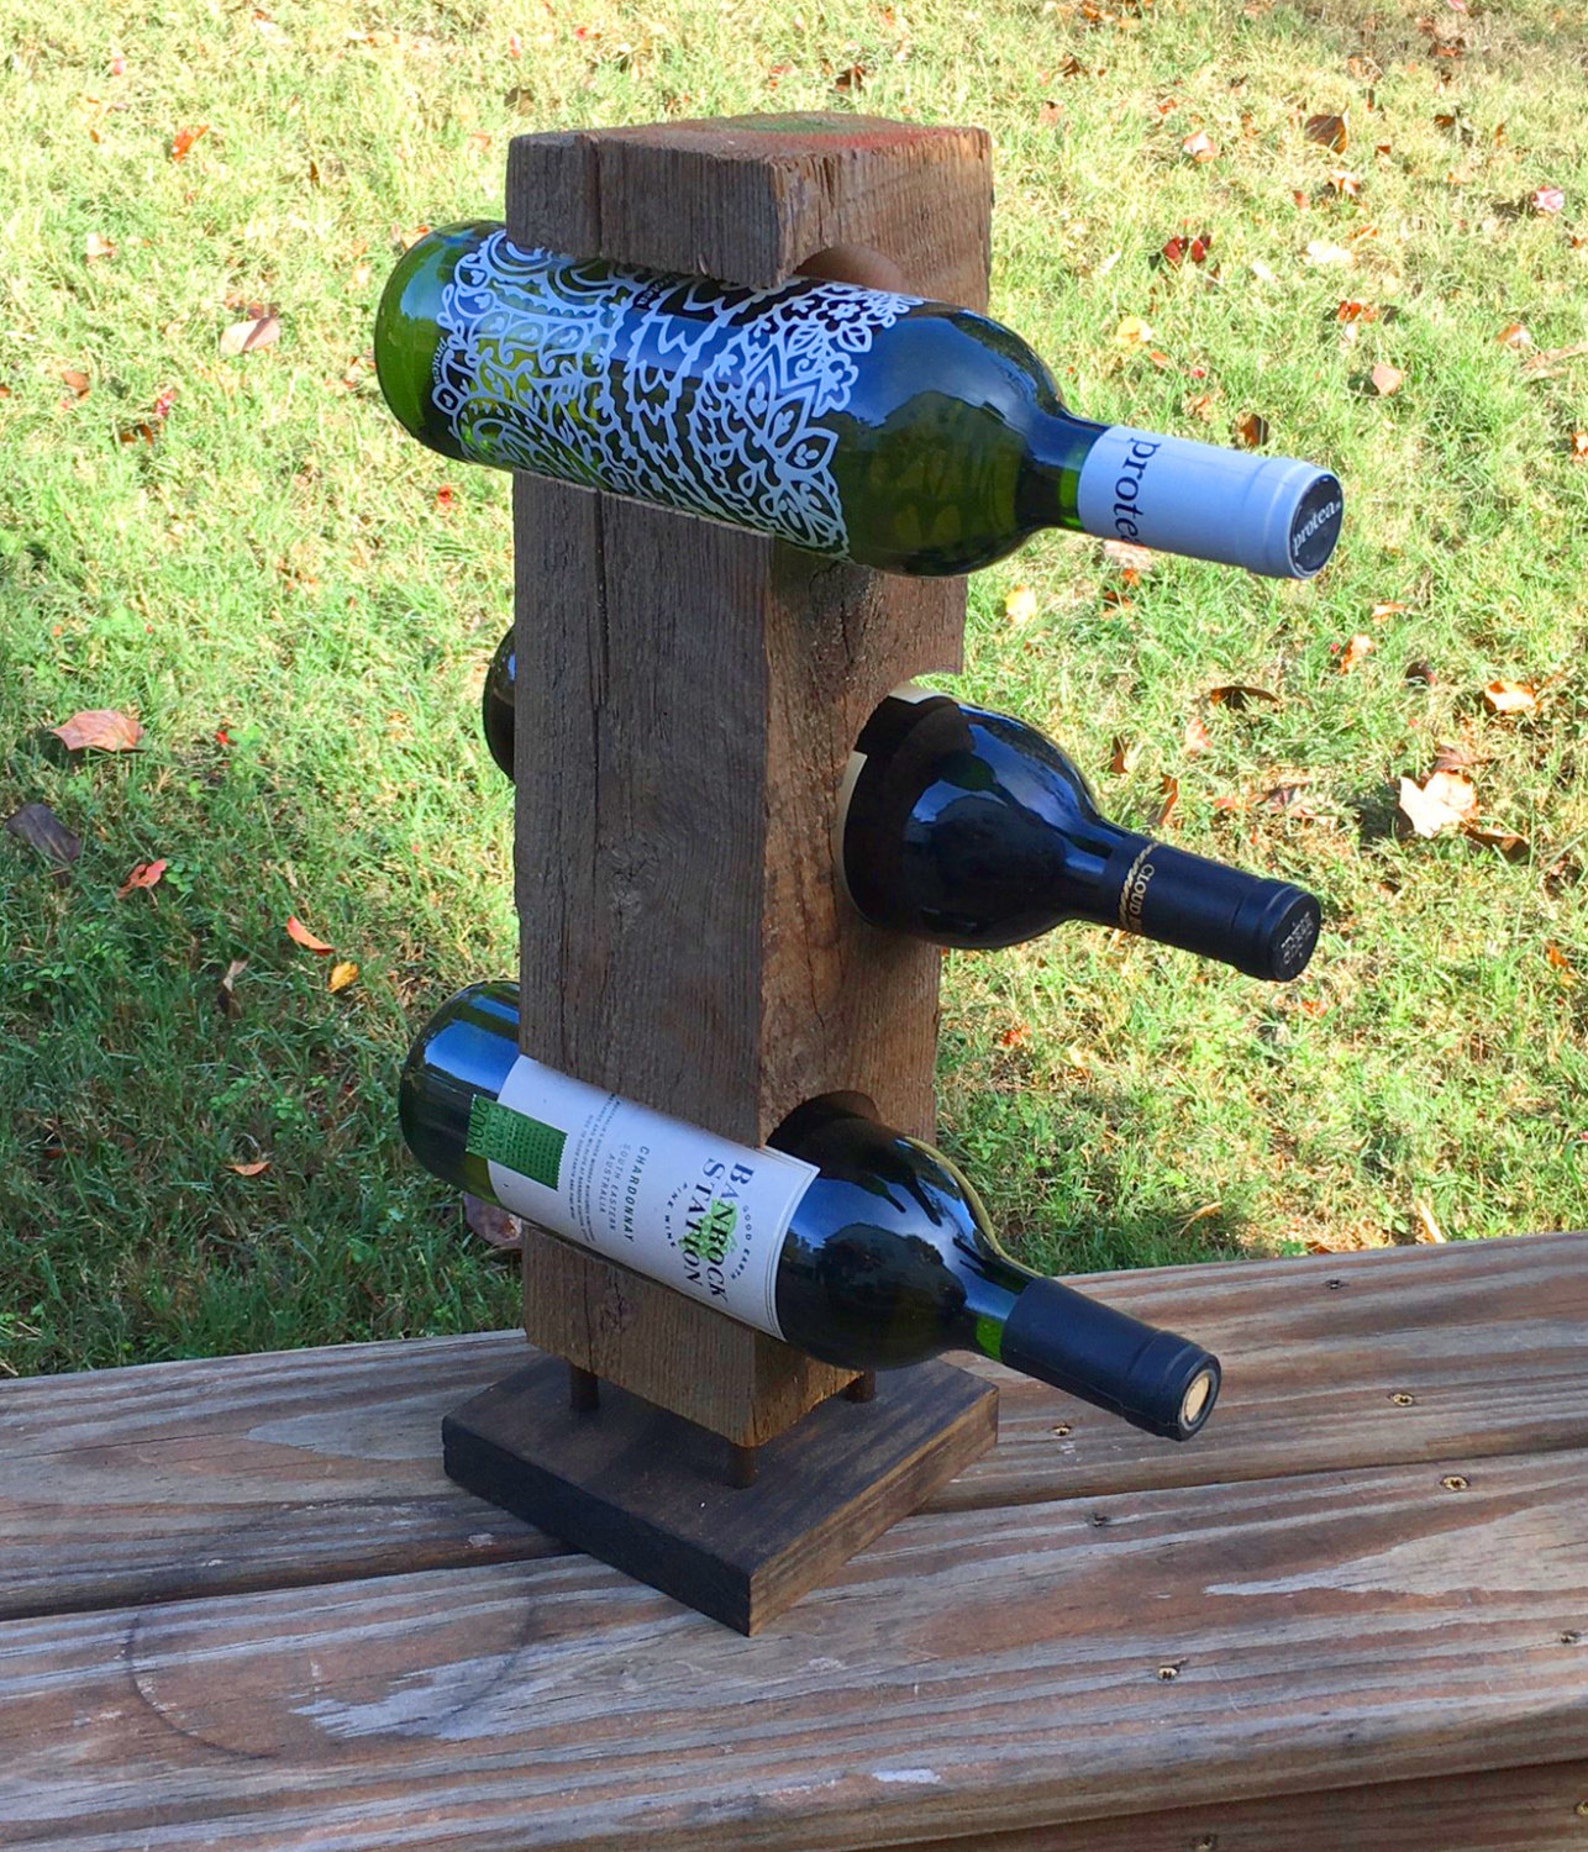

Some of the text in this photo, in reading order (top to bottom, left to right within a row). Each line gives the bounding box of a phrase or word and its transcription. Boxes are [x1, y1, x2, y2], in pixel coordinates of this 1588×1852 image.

[1293, 502, 1335, 557] protea
[1129, 863, 1155, 915] CLOUD
[466, 1101, 490, 1151] 2008
[600, 1152, 616, 1213] AUSTRALIA
[609, 1143, 632, 1231] SOUTH EASTERN
[624, 1145, 650, 1243] CHARDONNAY
[682, 1158, 726, 1287] STATION
[707, 1163, 755, 1302] BANROCK
[743, 1205, 752, 1241] GOOD
